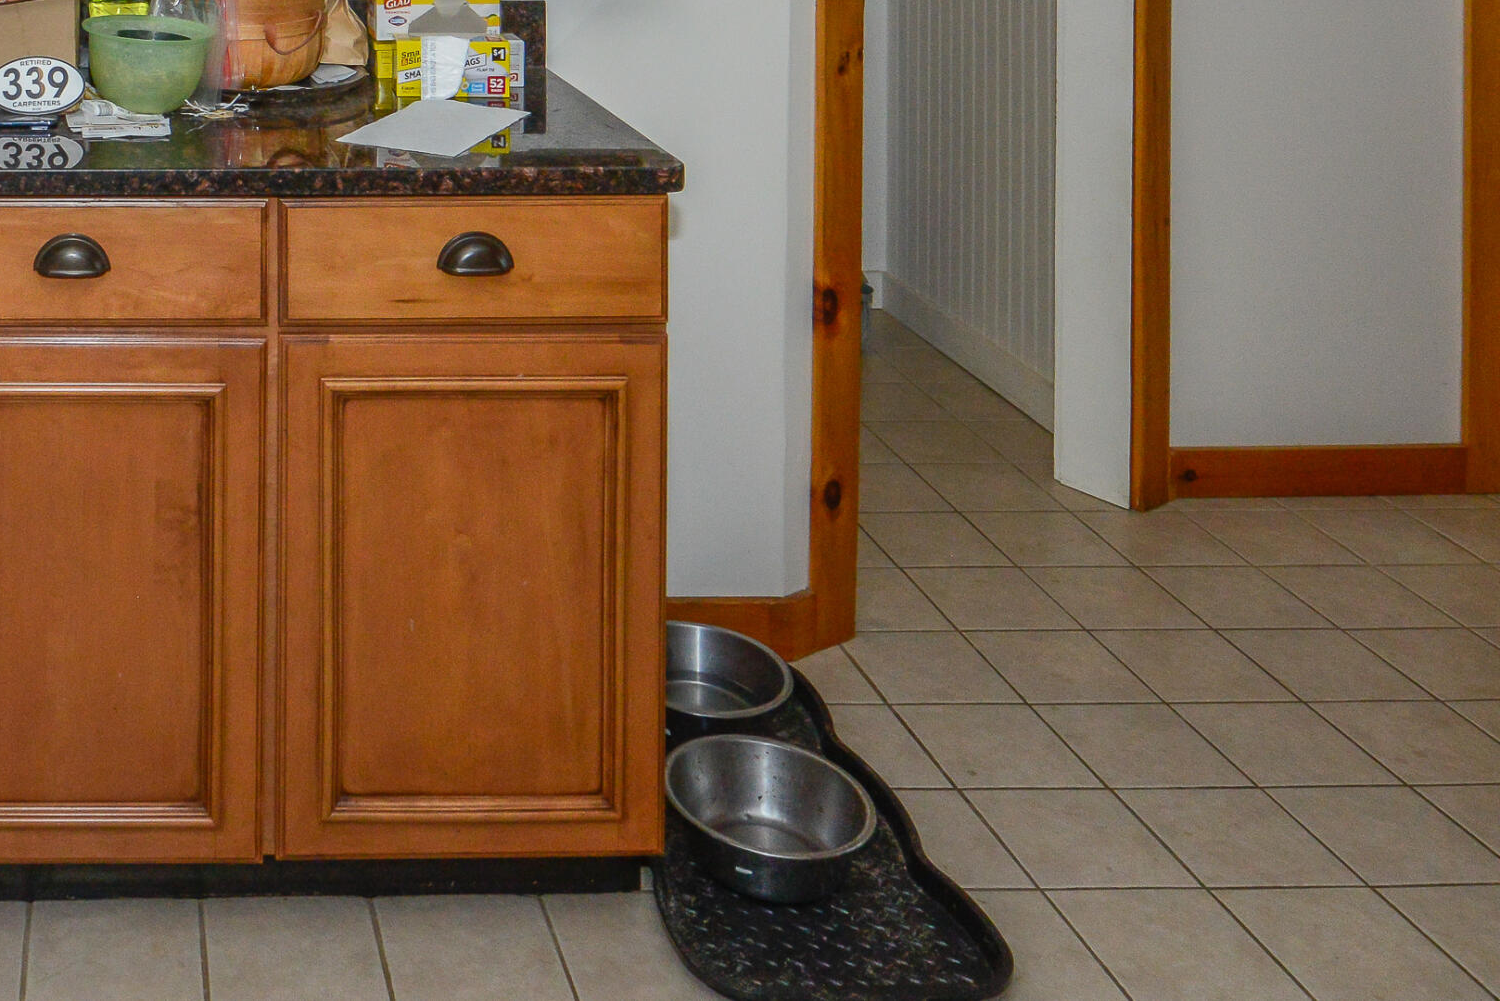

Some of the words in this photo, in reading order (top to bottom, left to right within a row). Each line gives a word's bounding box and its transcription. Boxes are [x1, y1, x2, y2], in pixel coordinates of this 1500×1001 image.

[401, 50, 420, 59] Sma
[493, 49, 505, 60] $1
[404, 70, 421, 80] SMA
[464, 56, 481, 67] AGS
[2, 66, 68, 100] 339
[489, 78, 504, 88] 52
